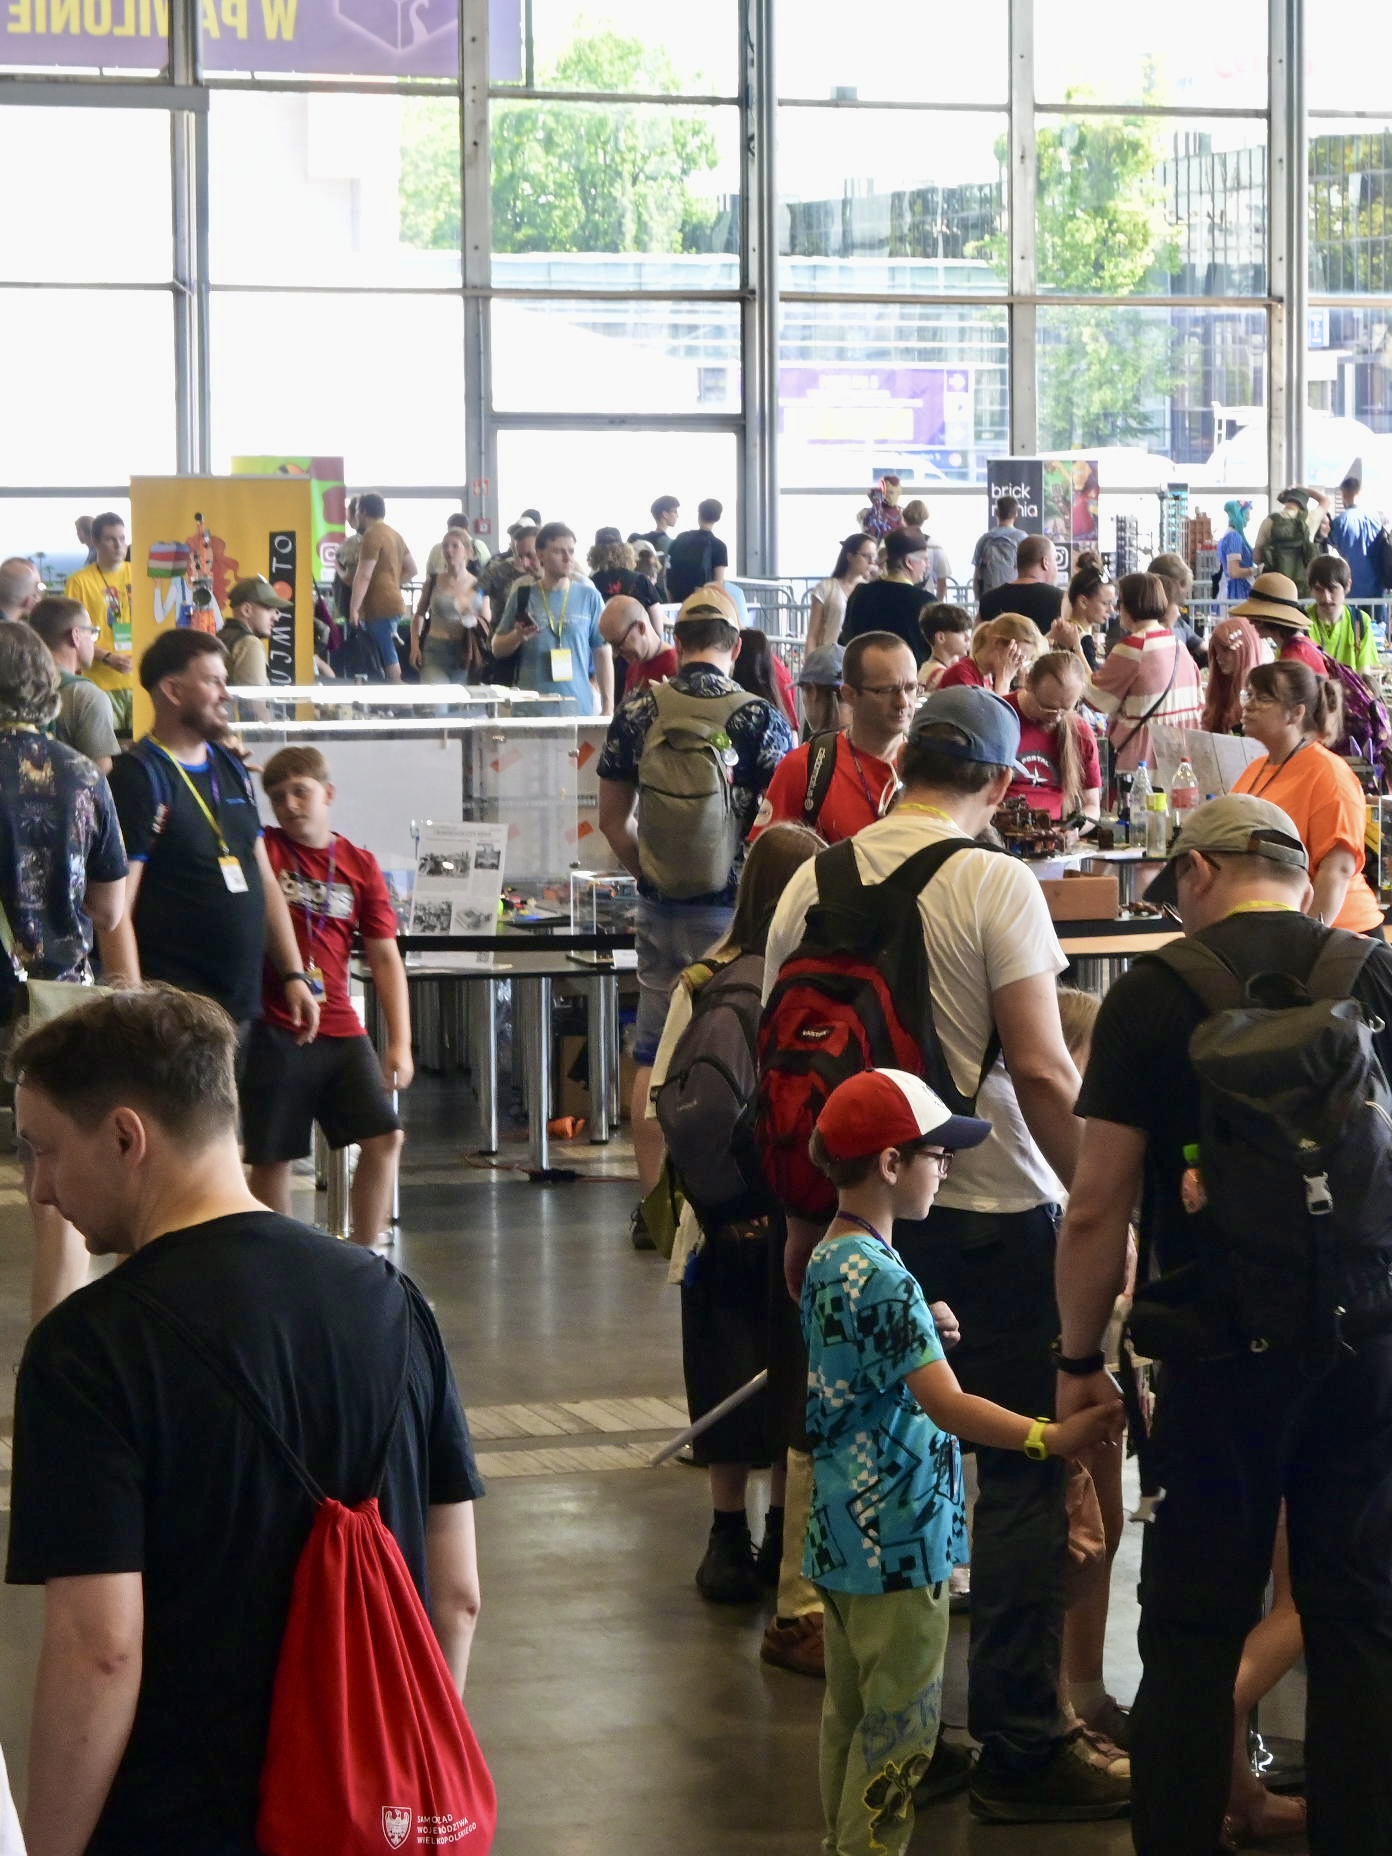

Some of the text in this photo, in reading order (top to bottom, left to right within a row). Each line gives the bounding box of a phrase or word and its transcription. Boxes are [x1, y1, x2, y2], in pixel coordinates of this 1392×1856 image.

[991, 482, 1031, 499] brick
[271, 534, 293, 574] TO
[1021, 755, 1050, 768] PORTAL
